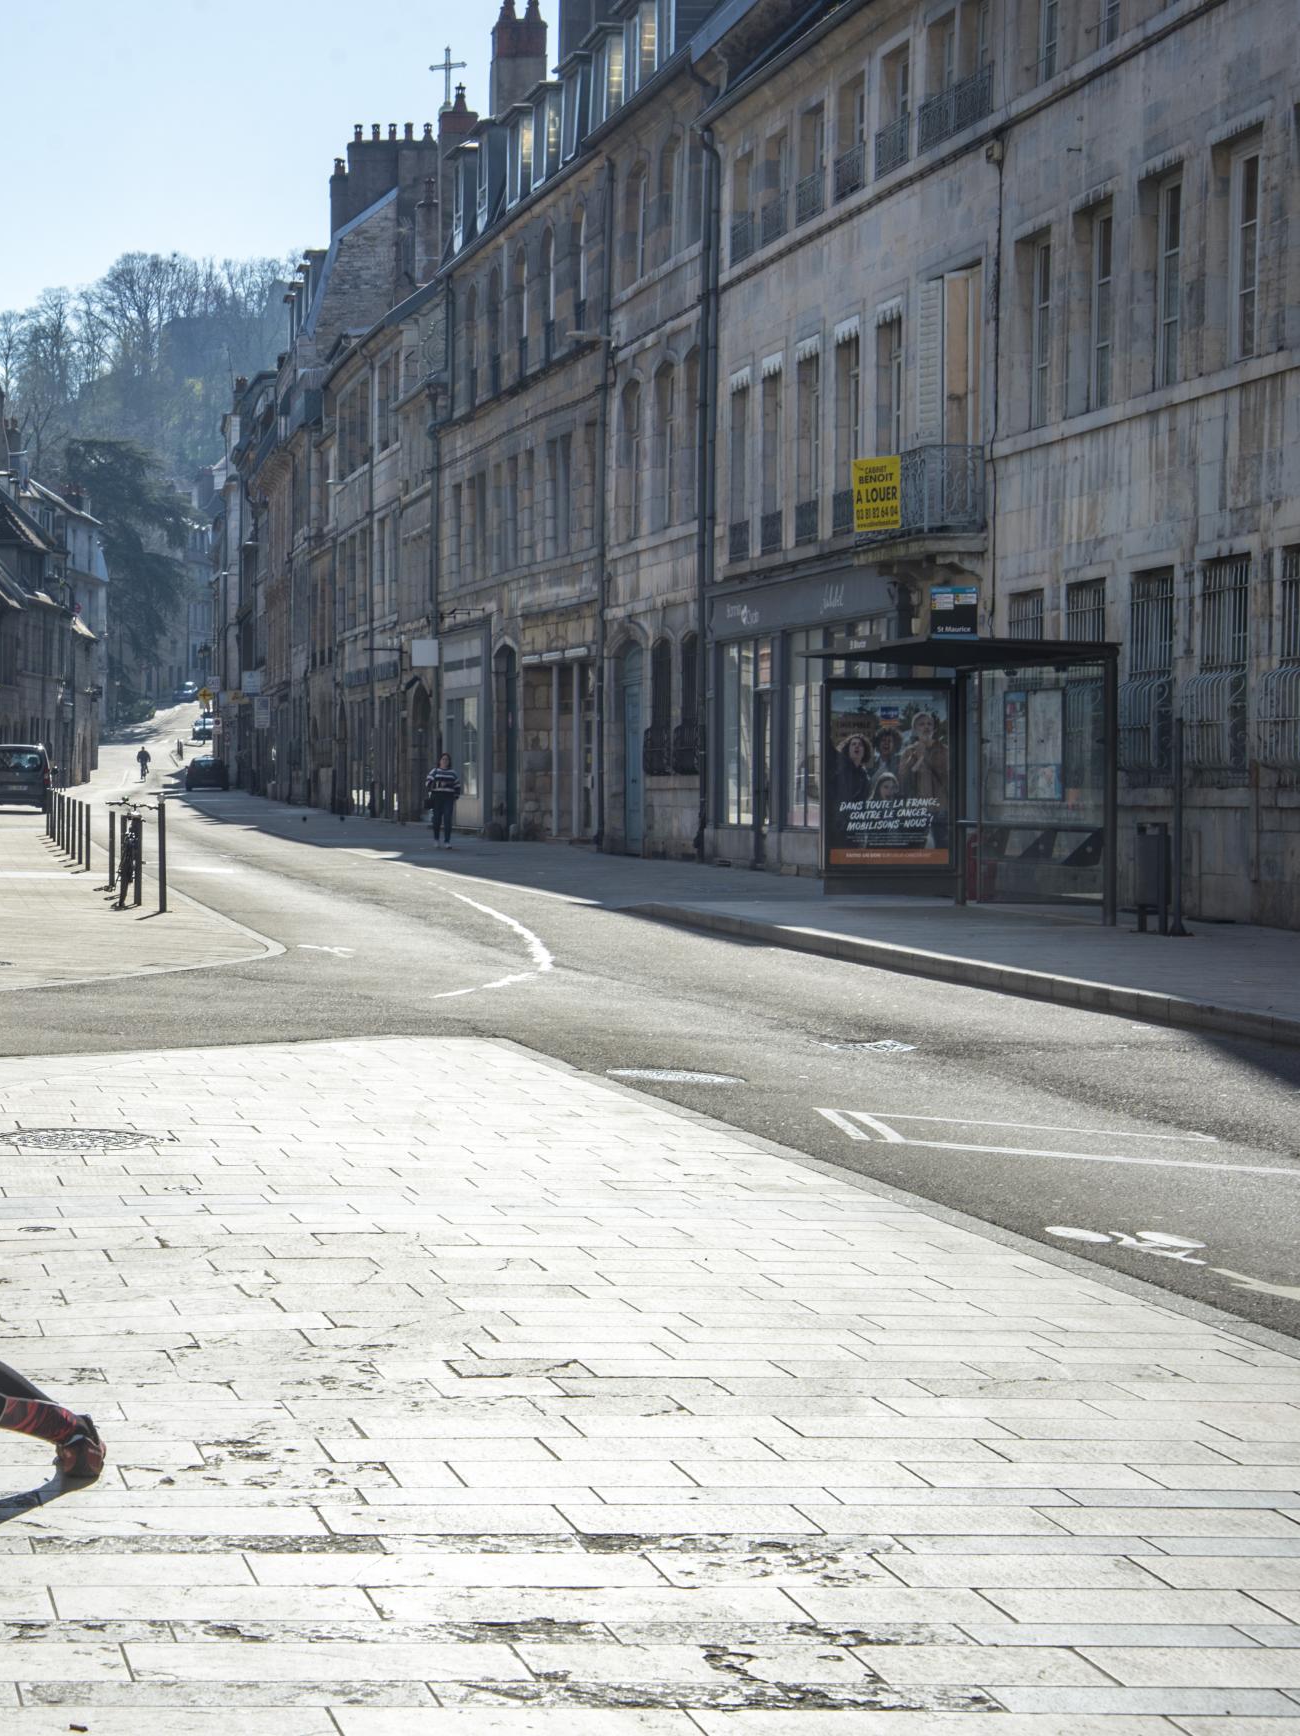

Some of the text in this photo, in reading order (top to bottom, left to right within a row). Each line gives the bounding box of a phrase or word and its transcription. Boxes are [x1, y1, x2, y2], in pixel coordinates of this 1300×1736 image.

[859, 473, 894, 484] BENOIT
[866, 486, 897, 503] LOUER
[937, 625, 972, 633] St Maurice
[839, 801, 863, 812] DANS
[866, 799, 892, 810] TOUTE
[893, 799, 904, 809] LA
[849, 810, 882, 820] CONTRE
[883, 809, 895, 818] LE
